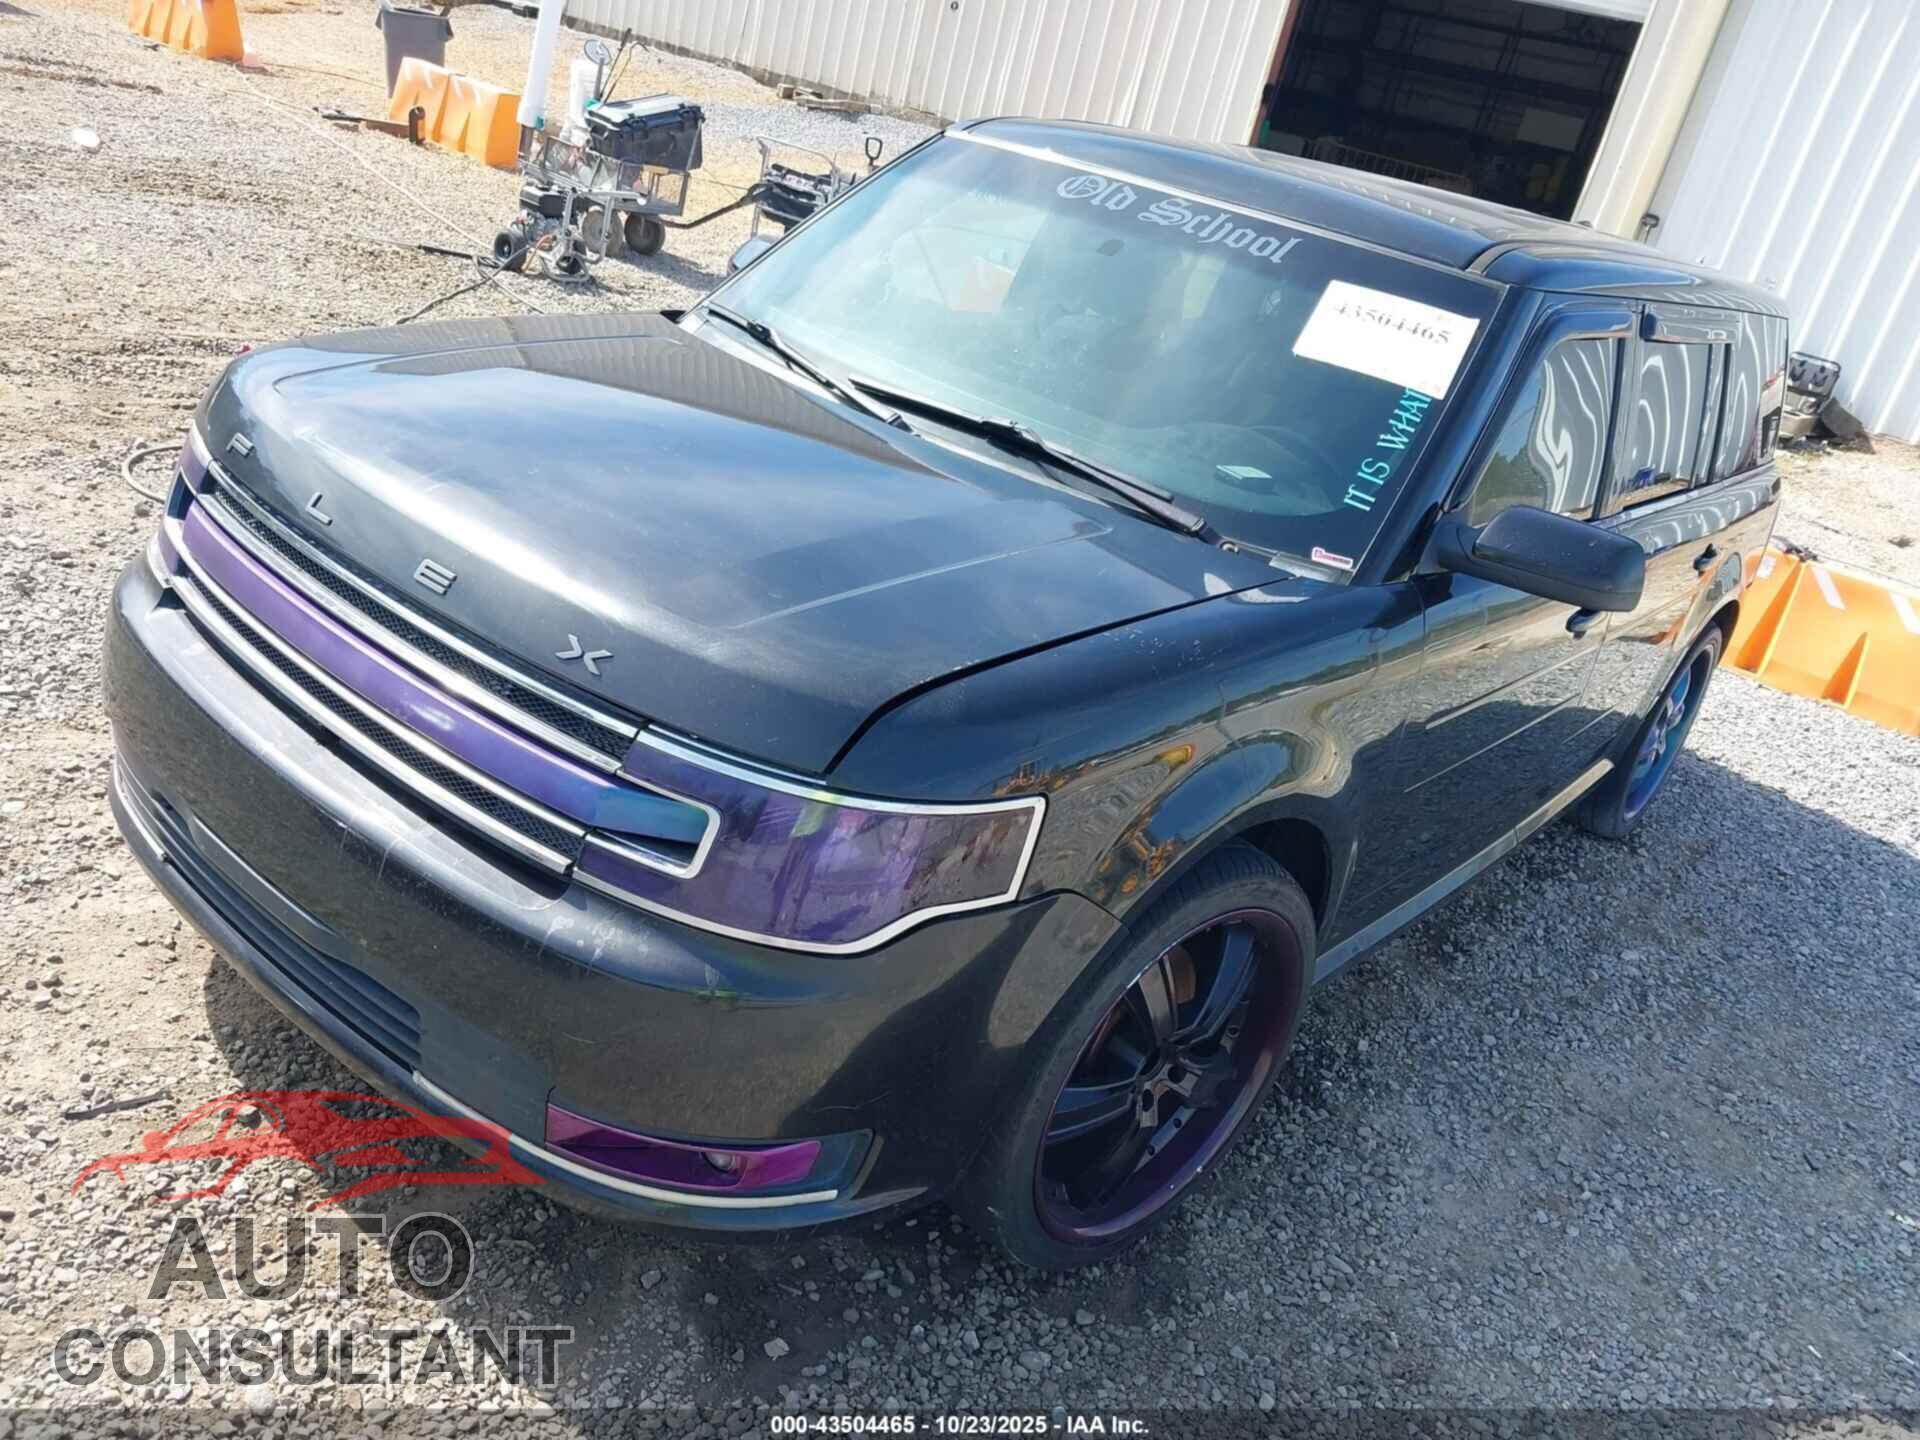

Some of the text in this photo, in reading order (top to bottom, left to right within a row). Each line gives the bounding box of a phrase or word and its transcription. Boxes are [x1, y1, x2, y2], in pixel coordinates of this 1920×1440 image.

[1056, 174, 1304, 264] Old School
[1333, 302, 1453, 344] 43504465
[1356, 457, 1391, 486] IS
[1343, 484, 1376, 512] IT
